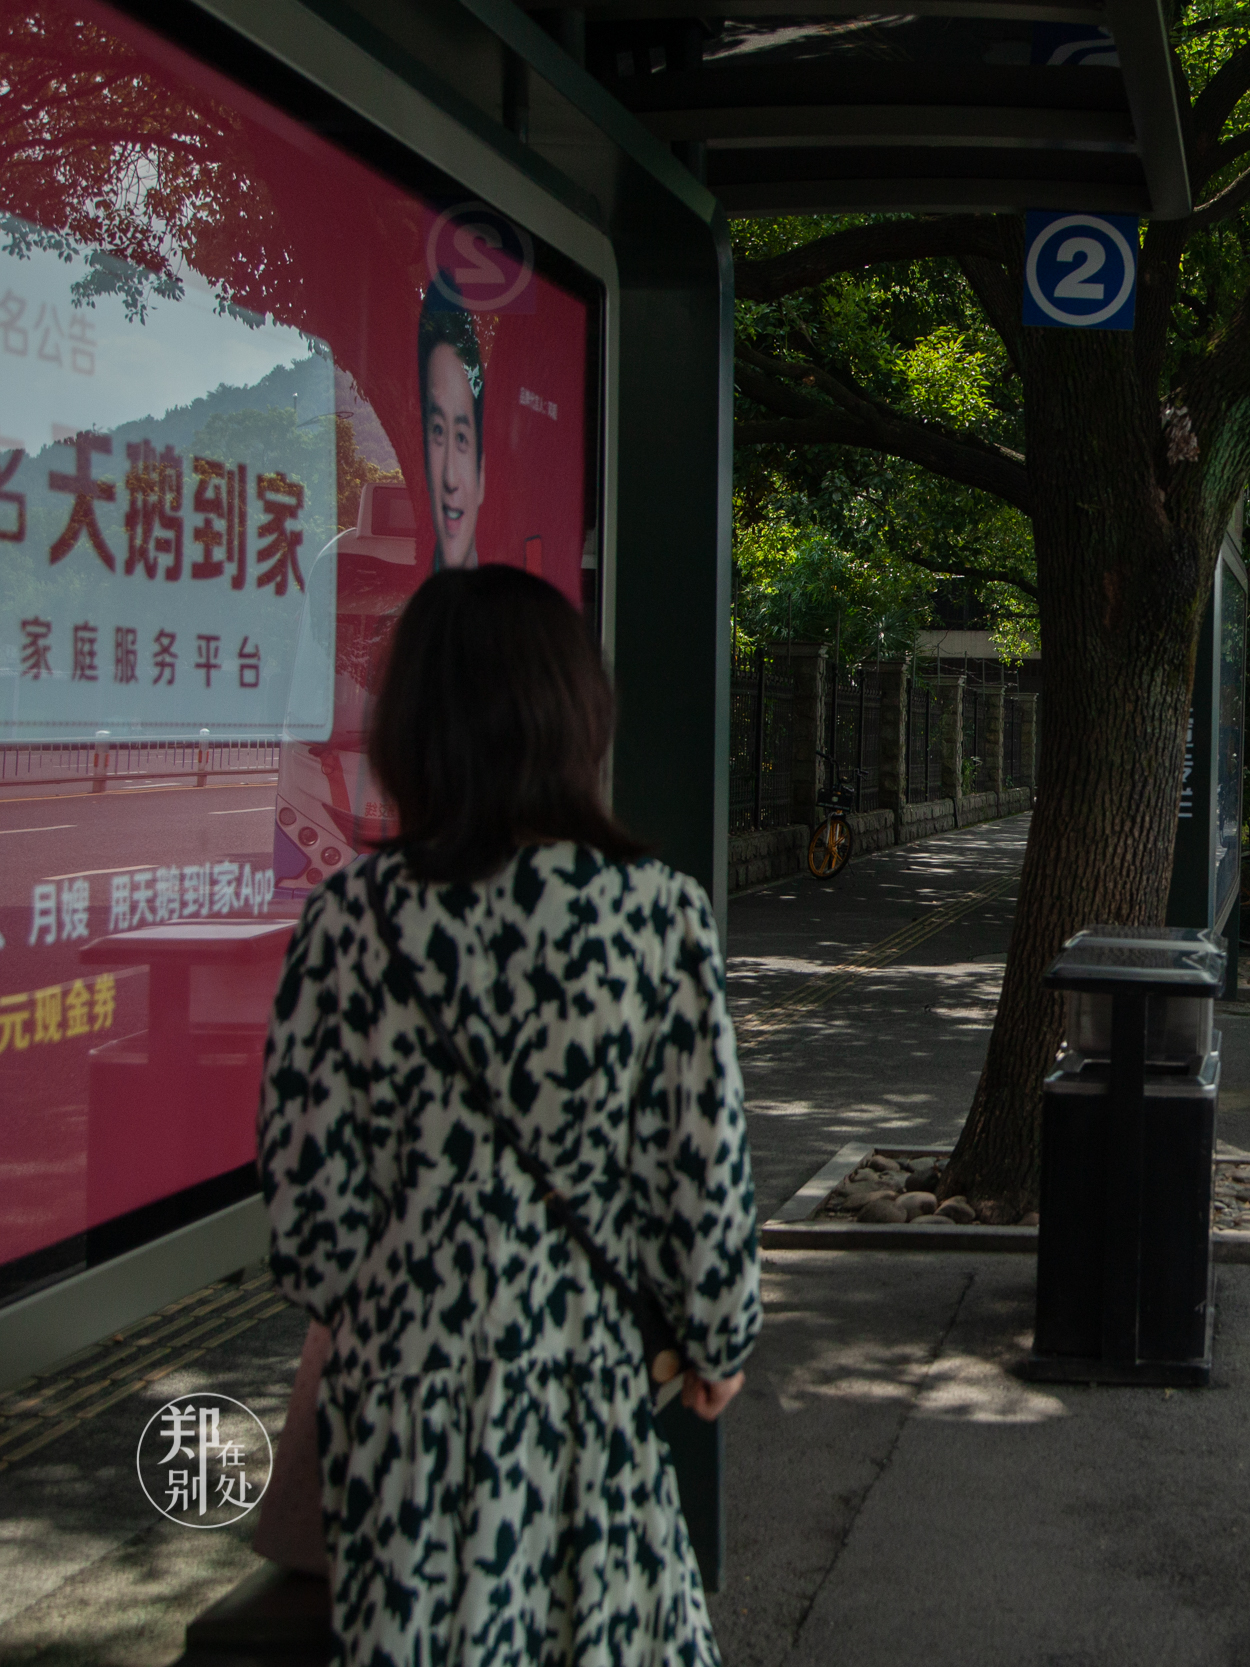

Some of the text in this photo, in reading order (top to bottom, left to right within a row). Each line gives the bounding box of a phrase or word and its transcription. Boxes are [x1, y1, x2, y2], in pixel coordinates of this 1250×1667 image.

[1053, 236, 1106, 300] 2
[0, 290, 97, 376] 名公告
[20, 615, 262, 688] 家庭服务平台
